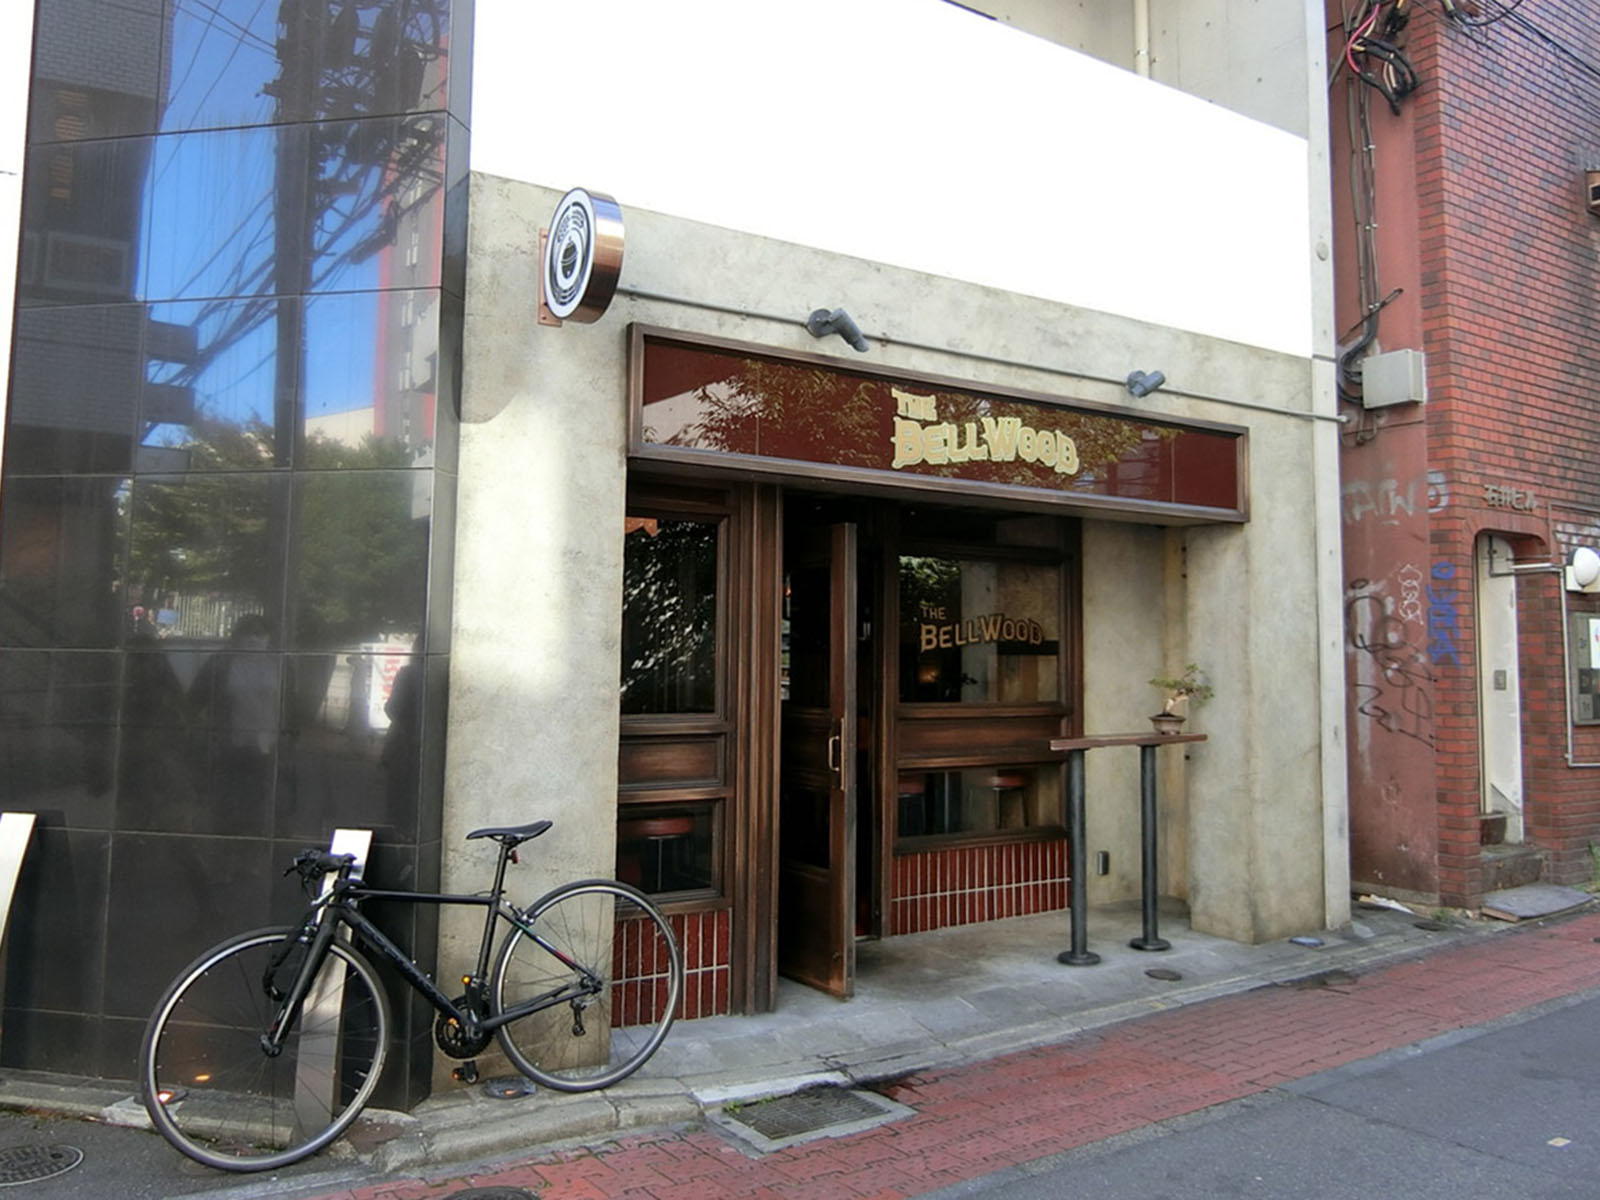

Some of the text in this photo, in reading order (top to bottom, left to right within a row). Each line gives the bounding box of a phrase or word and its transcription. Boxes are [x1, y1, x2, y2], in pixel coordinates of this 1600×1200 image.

[891, 387, 938, 421] THE
[920, 604, 946, 620] THE
[920, 613, 1043, 653] BELLWOOD
